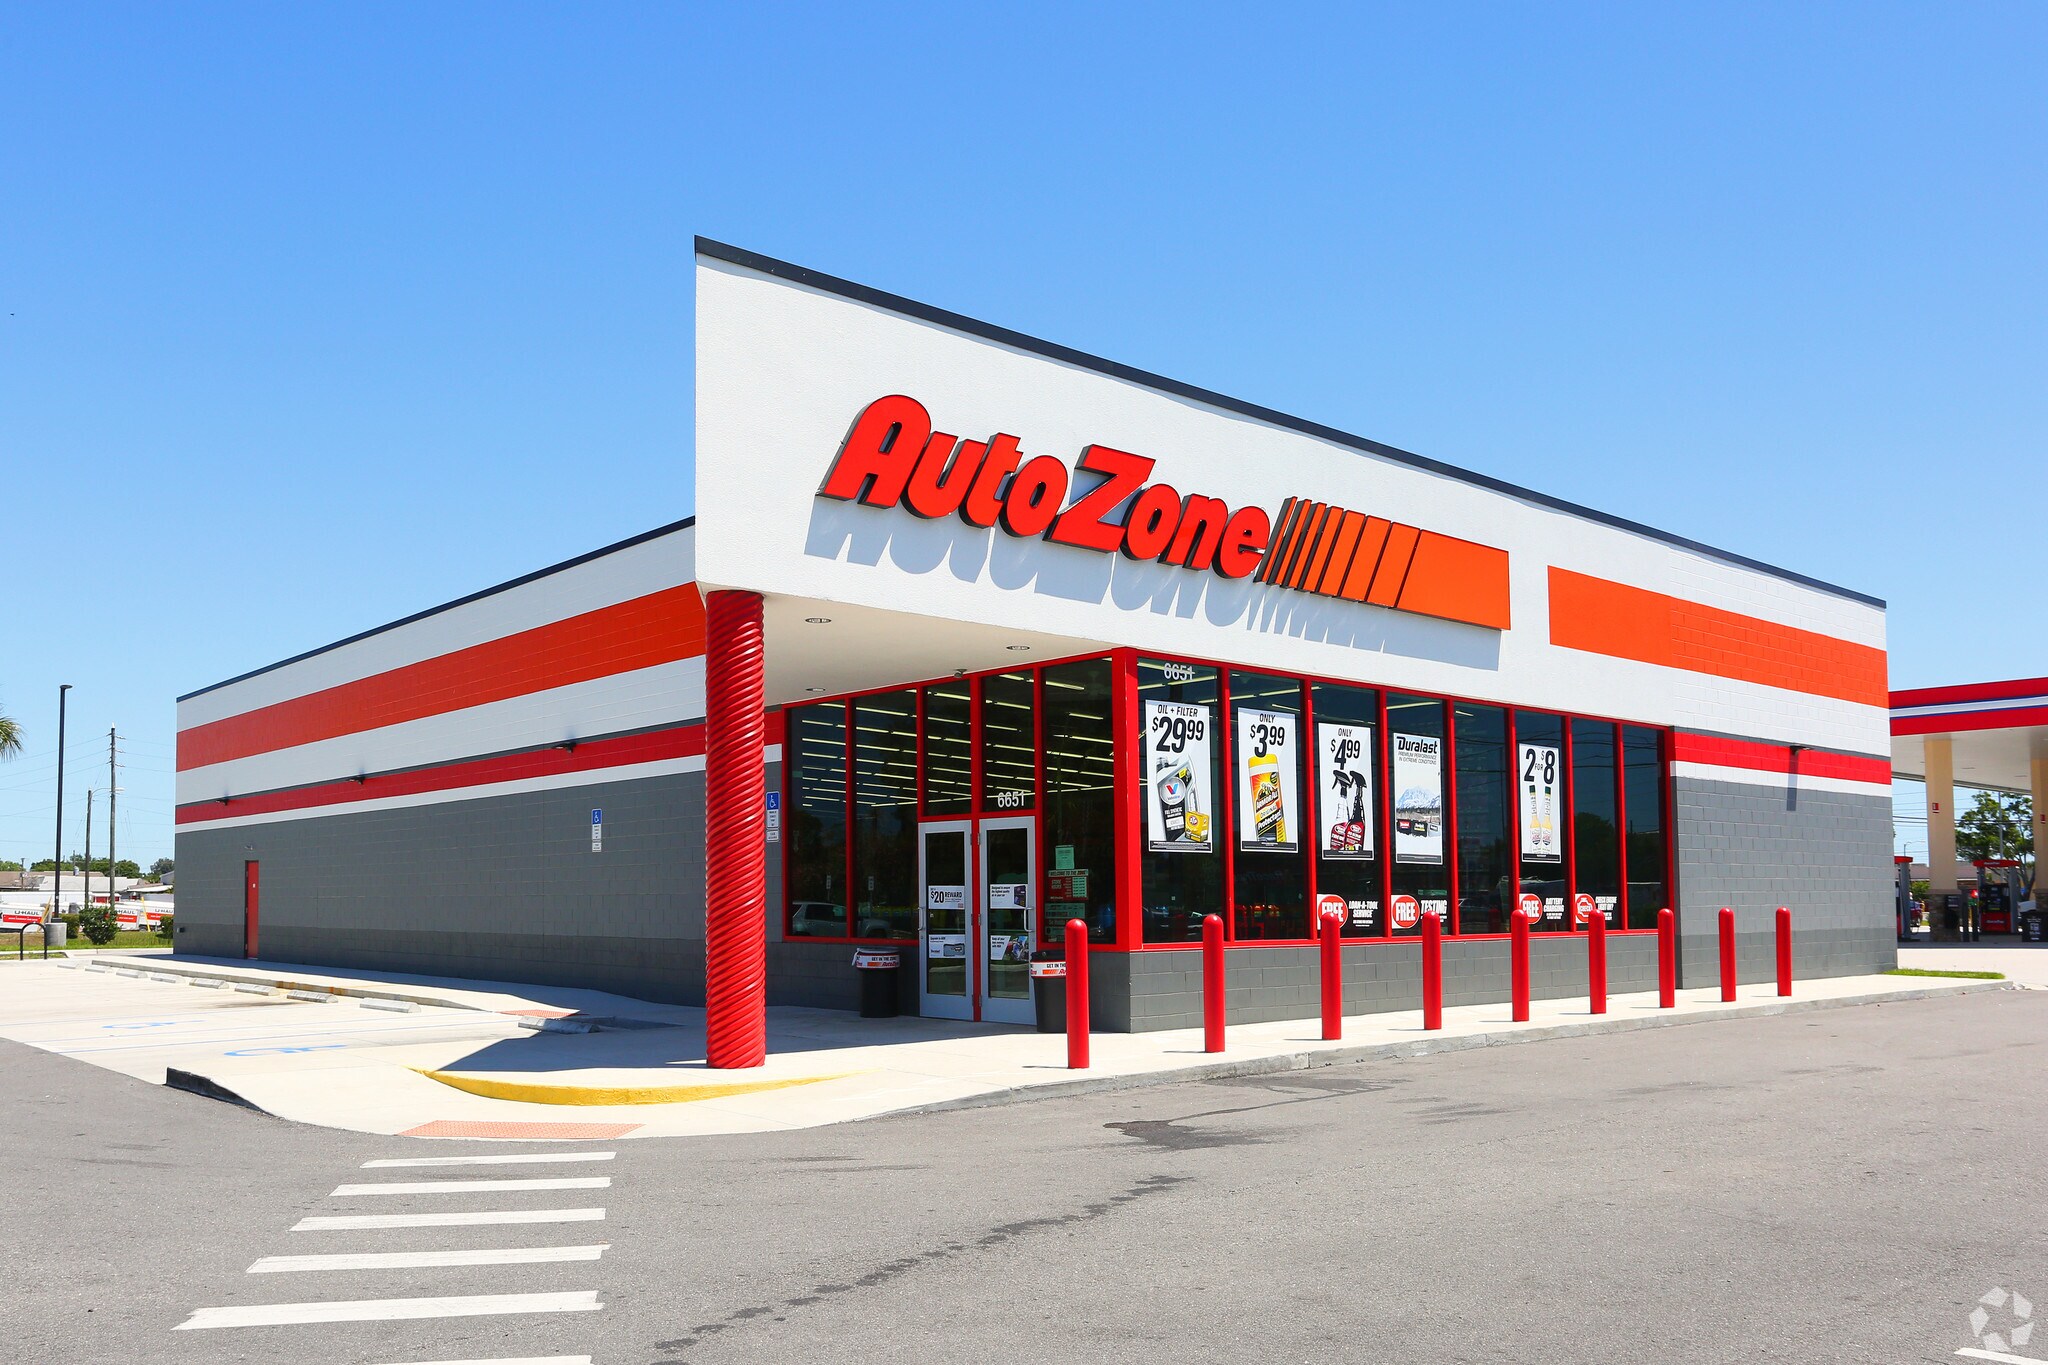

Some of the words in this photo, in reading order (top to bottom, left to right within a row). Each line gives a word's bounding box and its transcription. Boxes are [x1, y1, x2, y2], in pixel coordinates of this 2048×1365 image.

[818, 394, 1271, 579] AutoZone
[1164, 662, 1193, 680] 6651
[1157, 704, 1168, 714] OIL
[1176, 706, 1198, 717] FILTER
[1259, 713, 1276, 723] ONLY
[1337, 727, 1353, 737] ONLY
[1396, 736, 1438, 754] Duralast
[1524, 748, 1536, 782] 2
[1535, 763, 1543, 771] FOR
[997, 789, 1025, 808] 6651
[930, 890, 944, 903] $20
[1353, 909, 1374, 918] SERVICE
[1395, 902, 1416, 922] FREE
[1420, 900, 1447, 914] TESTING
[1521, 900, 1540, 917] FREE
